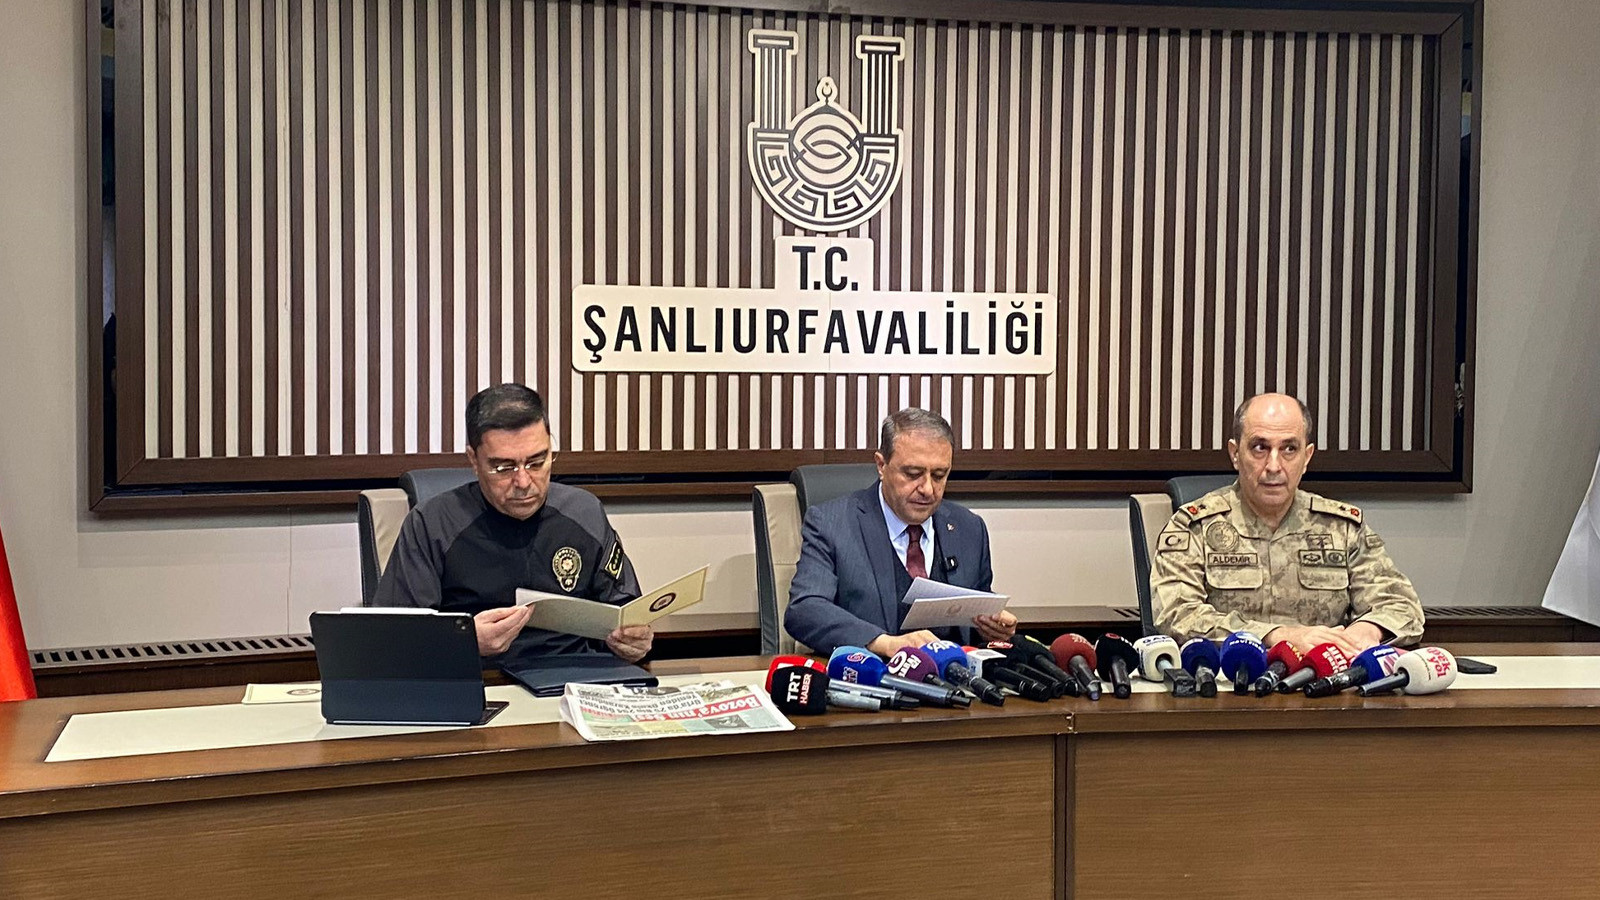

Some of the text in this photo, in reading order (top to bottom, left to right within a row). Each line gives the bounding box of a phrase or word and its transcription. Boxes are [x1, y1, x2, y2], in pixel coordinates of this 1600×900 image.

[792, 246, 859, 291] T.C.
[787, 672, 801, 702] TRT
[800, 674, 812, 704] HABER
